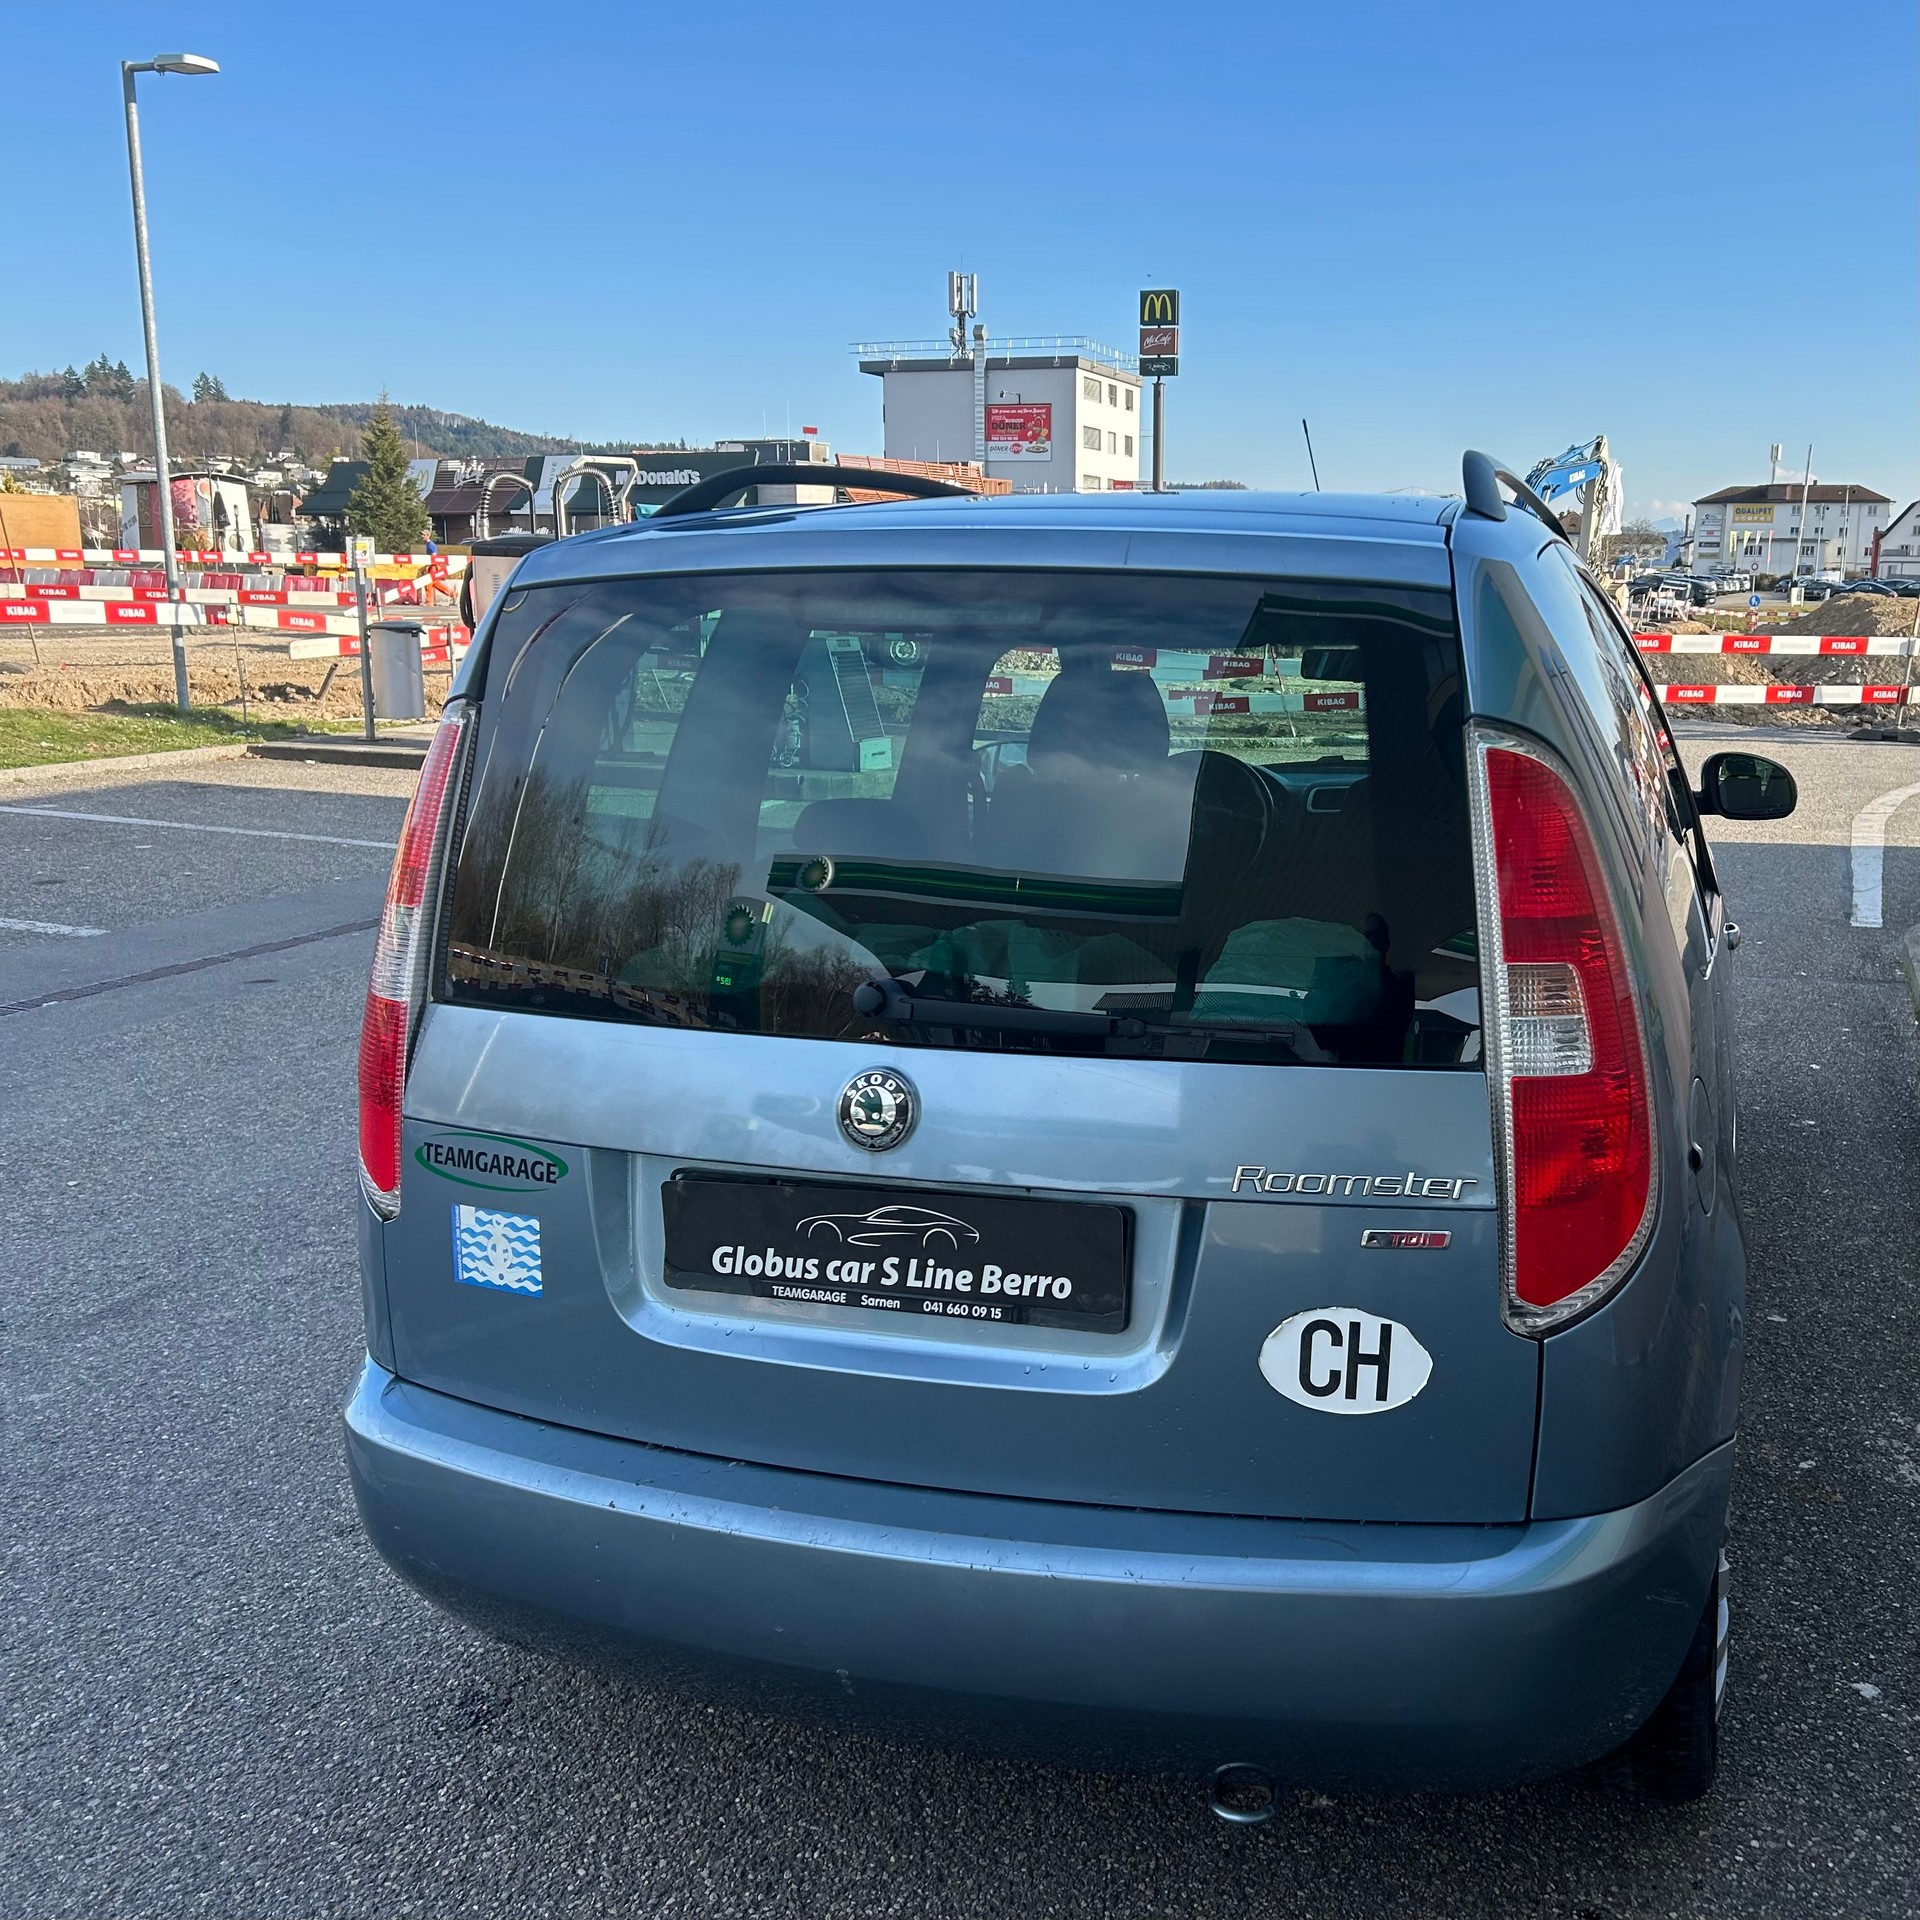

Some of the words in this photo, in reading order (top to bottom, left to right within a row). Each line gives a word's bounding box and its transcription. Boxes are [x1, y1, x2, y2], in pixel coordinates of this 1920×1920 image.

[6, 606, 37, 616] KIBAG
[118, 608, 146, 618] KIBAG
[290, 617, 315, 627] KIBAG
[440, 631, 461, 640] KIAG
[1831, 642, 1857, 650] KIBAG
[1223, 660, 1250, 668] KIBAG
[1777, 690, 1803, 698] KIBAG
[1318, 698, 1345, 706] KIBAG
[424, 1142, 557, 1184] TEAMGARAGE
[1232, 1165, 1478, 1200] Roomster
[712, 1245, 819, 1279] Globus
[825, 1259, 876, 1284] car
[881, 1257, 900, 1285] S
[906, 1259, 972, 1293] Line
[980, 1264, 1072, 1300] Berro
[772, 1285, 847, 1304] TEAMGARAGE
[860, 1294, 900, 1309] Sarnen
[923, 1300, 944, 1314] 041
[946, 1303, 969, 1316] 660
[971, 1305, 988, 1318] 09
[989, 1306, 1002, 1319] 15
[1299, 1319, 1392, 1402] CH
